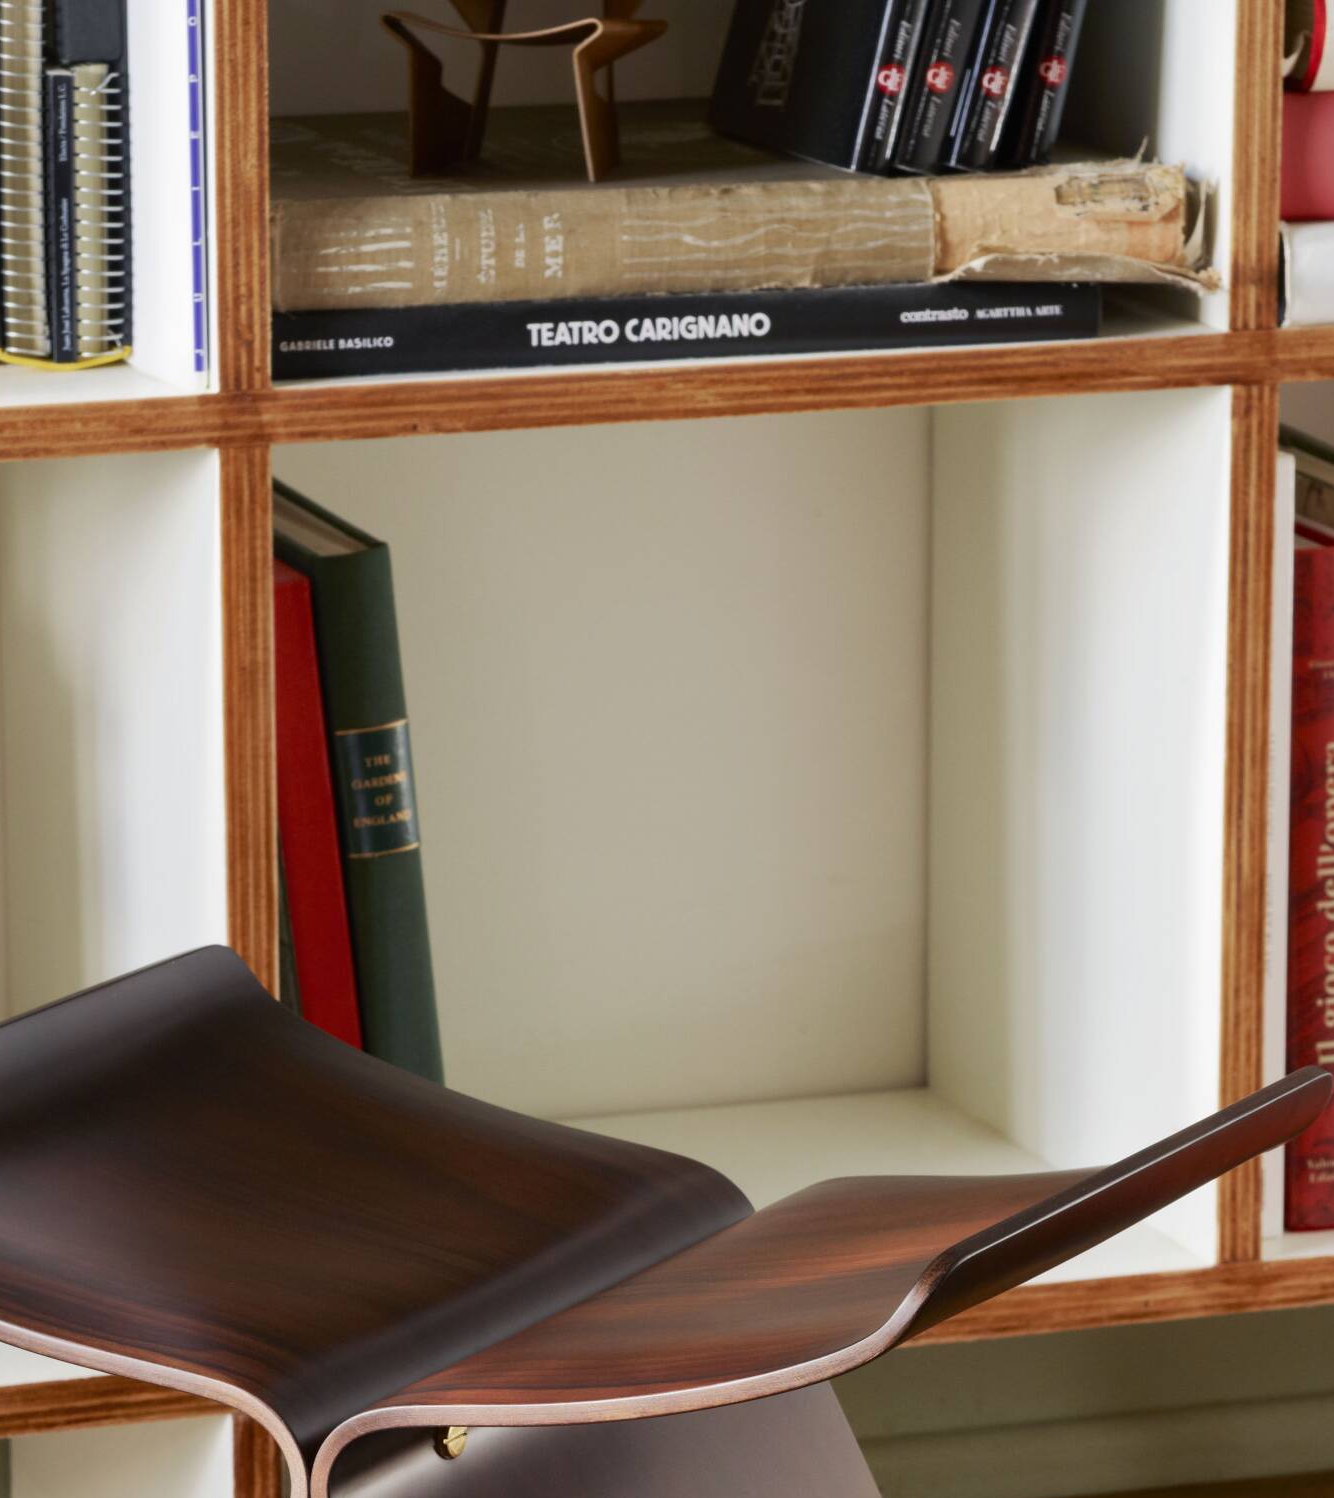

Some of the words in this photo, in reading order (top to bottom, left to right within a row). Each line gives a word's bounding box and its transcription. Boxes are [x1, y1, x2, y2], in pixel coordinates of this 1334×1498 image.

[543, 212, 565, 280] MER
[900, 307, 969, 323] contrasto
[527, 319, 618, 348] TEATRO
[624, 312, 771, 343] CARIGNANO
[279, 339, 336, 352] GABRIELE
[338, 336, 394, 350] BASILICO
[364, 753, 392, 768] THE
[373, 793, 394, 806] OF
[352, 808, 412, 828] ENGLAND
